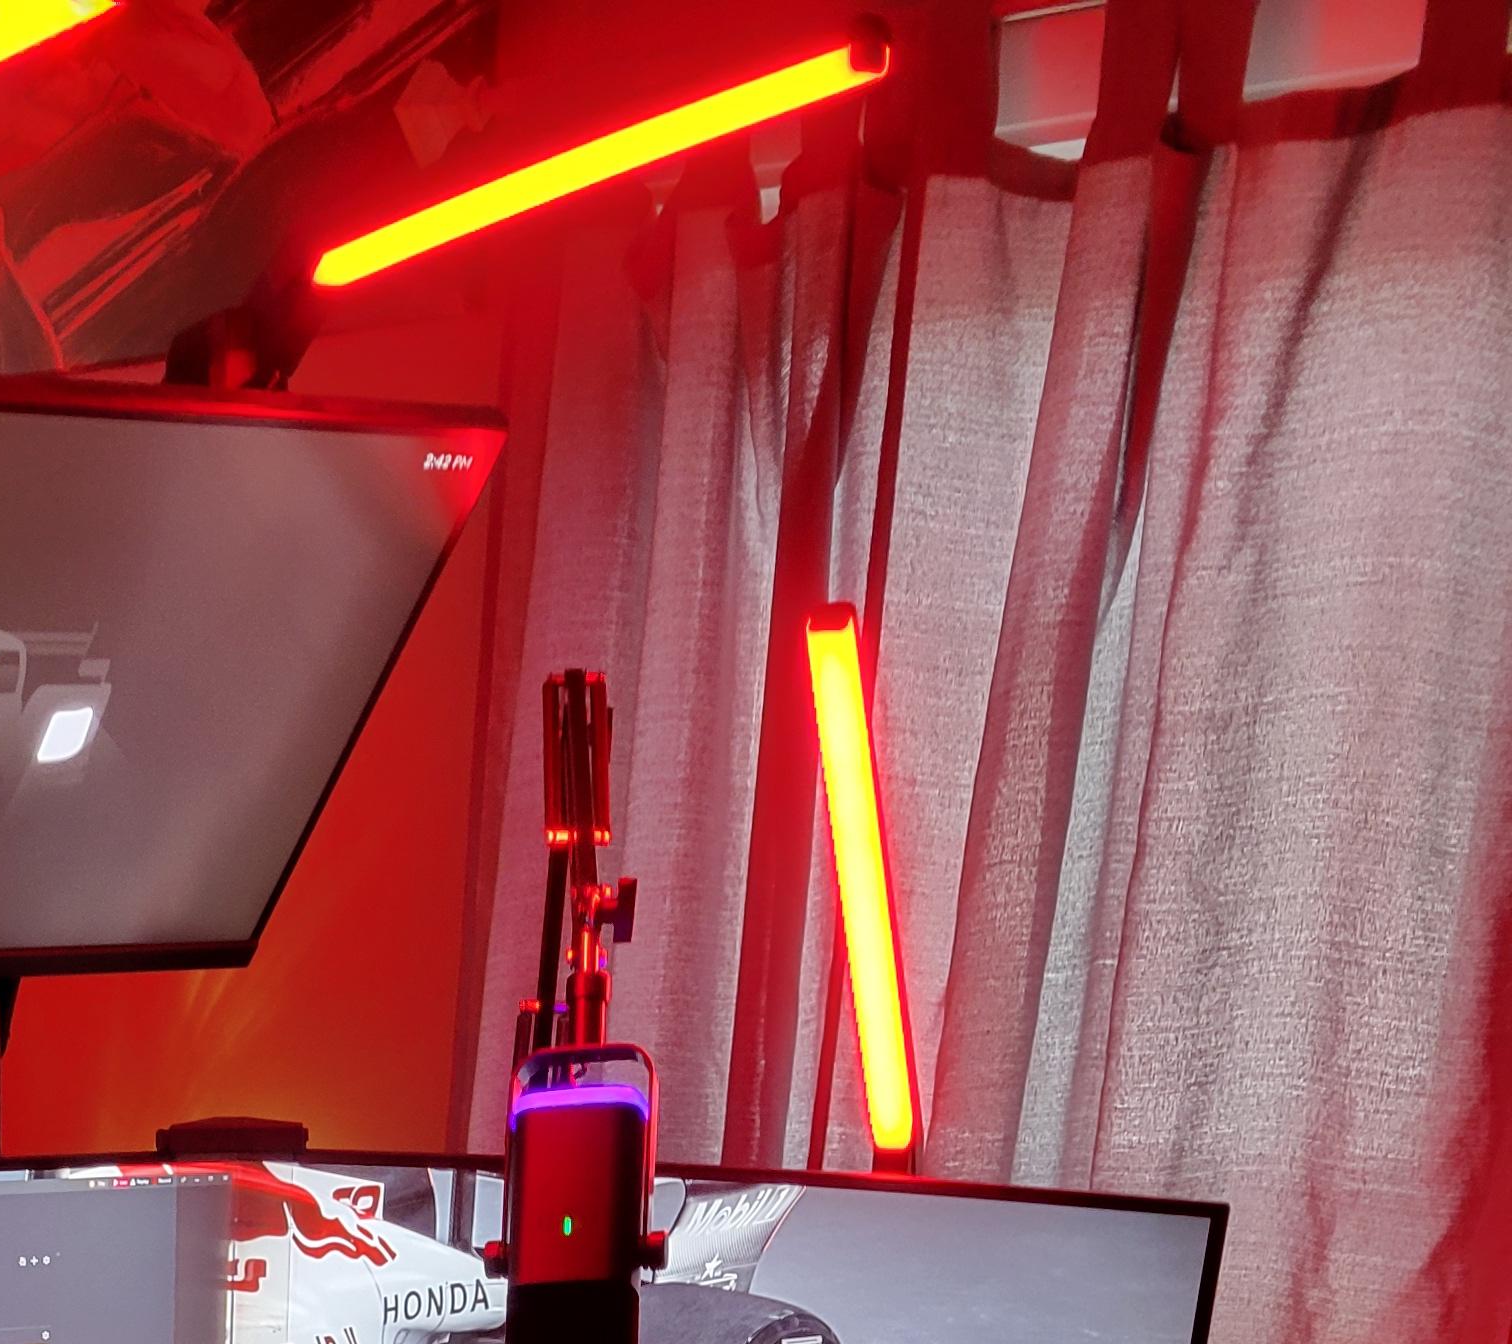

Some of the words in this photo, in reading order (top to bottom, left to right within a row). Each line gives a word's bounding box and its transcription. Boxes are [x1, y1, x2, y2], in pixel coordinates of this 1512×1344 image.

[452, 454, 473, 471] PM
[687, 1187, 773, 1236] Mobil
[382, 1278, 490, 1325] HONDA
